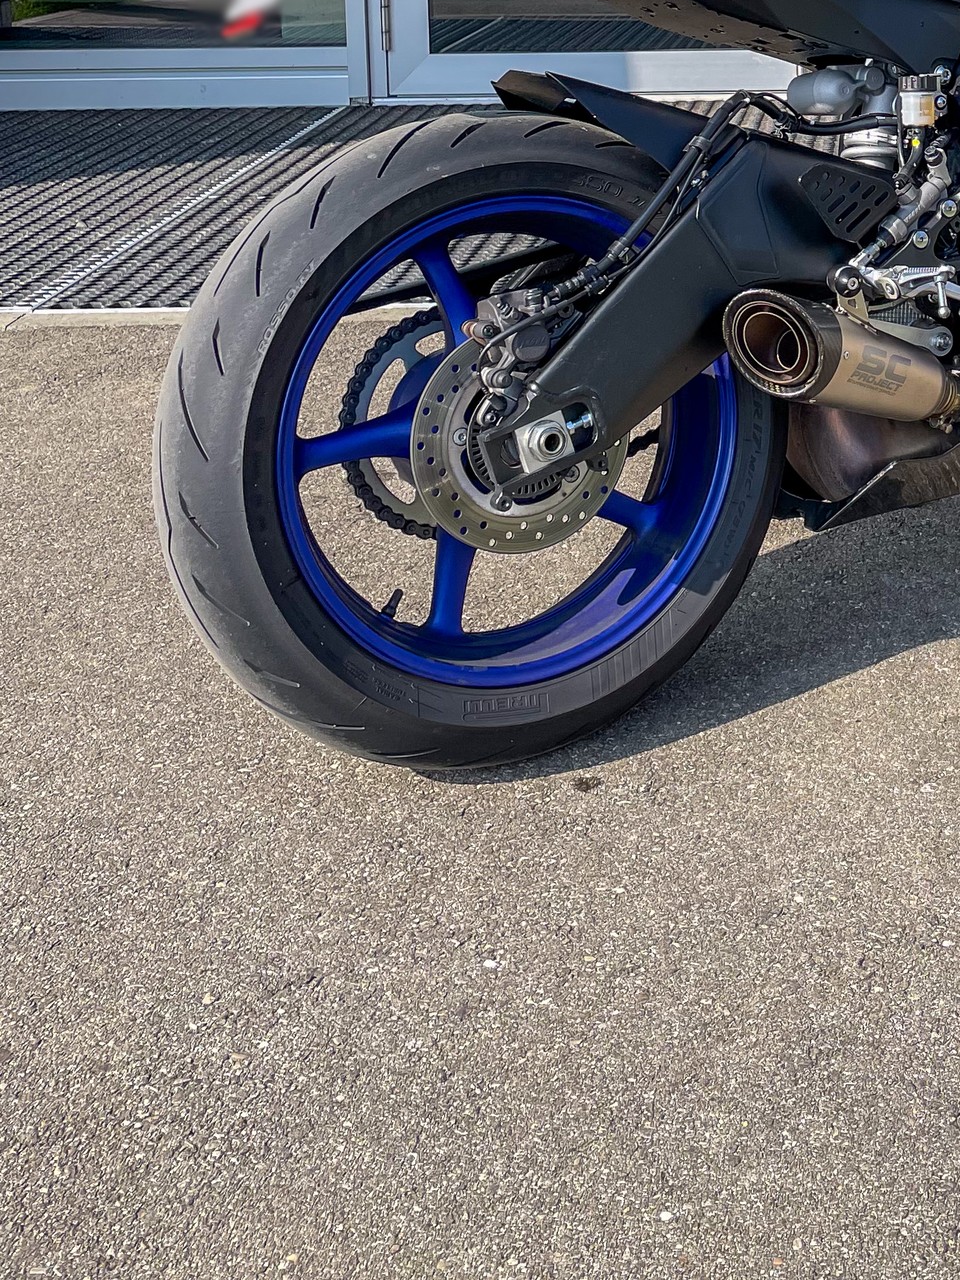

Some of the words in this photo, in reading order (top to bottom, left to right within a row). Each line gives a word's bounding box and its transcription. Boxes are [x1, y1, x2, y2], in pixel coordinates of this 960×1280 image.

[856, 344, 912, 385] SC
[850, 369, 903, 392] PROJECT
[461, 693, 550, 721] PIRELLI
